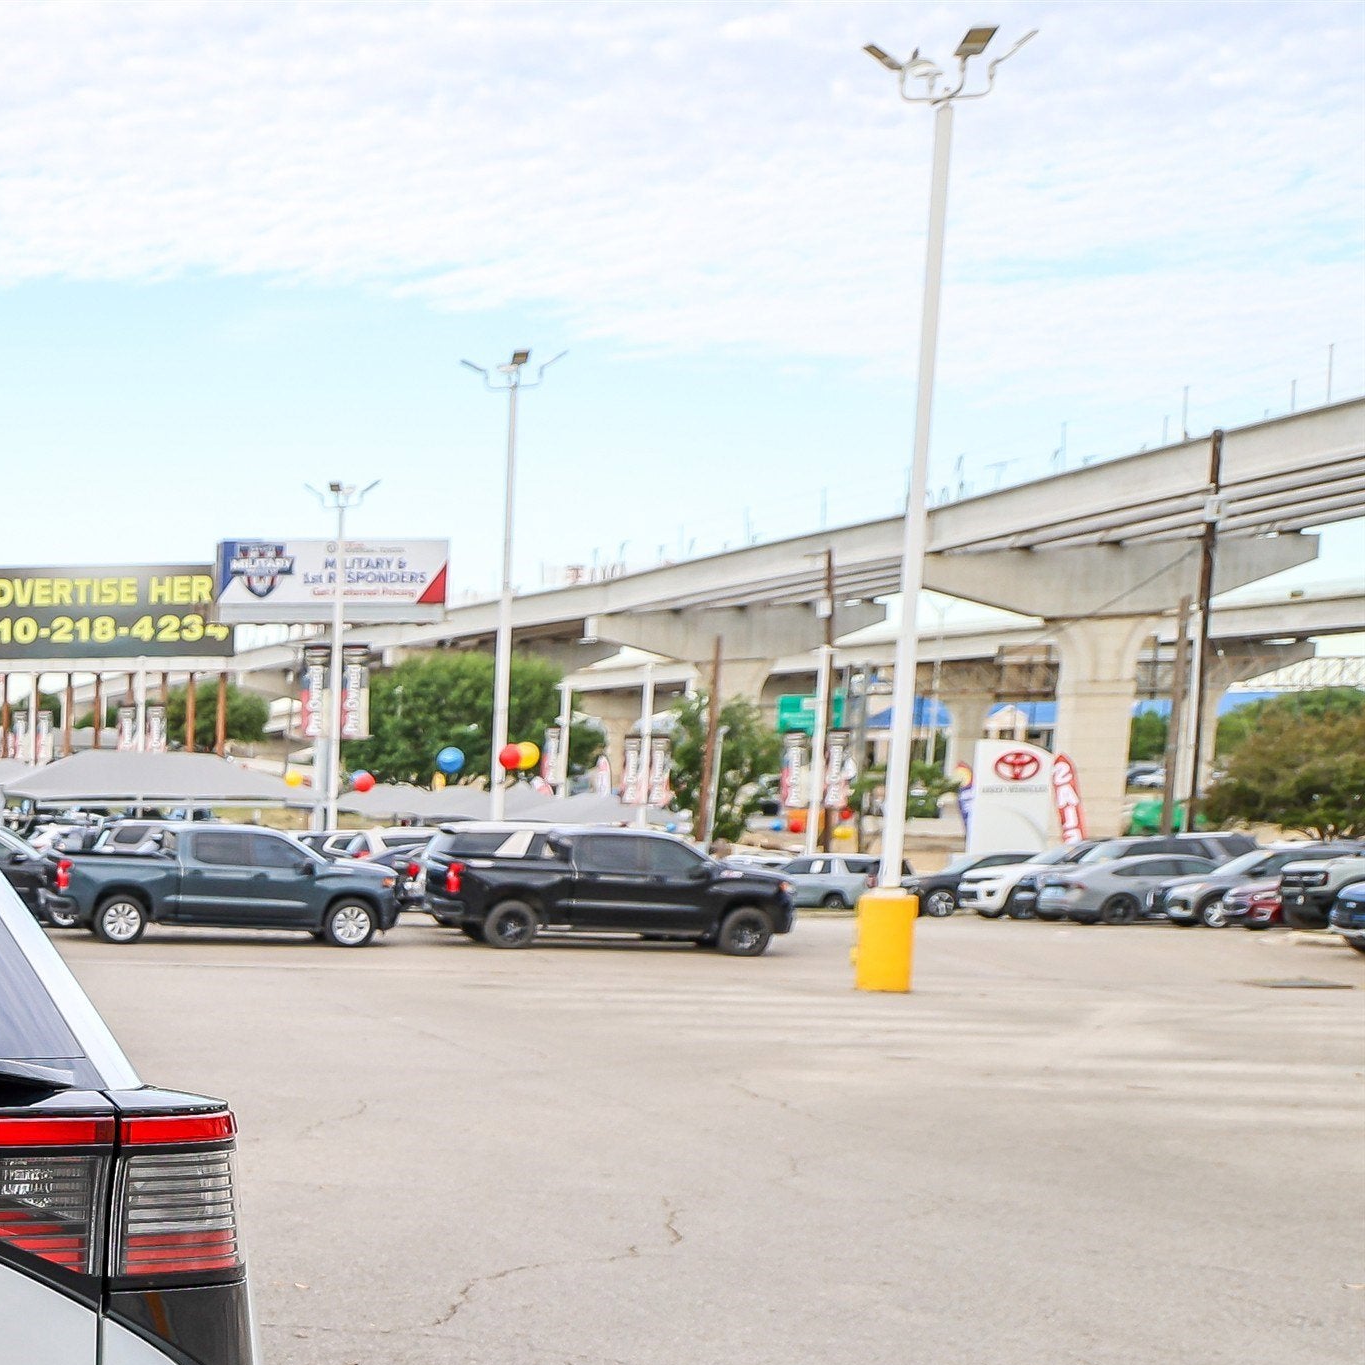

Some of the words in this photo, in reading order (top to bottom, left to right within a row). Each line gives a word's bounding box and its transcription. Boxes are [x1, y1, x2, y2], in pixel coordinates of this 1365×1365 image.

[324, 557, 393, 570] MLITARY
[327, 571, 427, 584] RSPONDERS
[148, 574, 214, 606] HER
